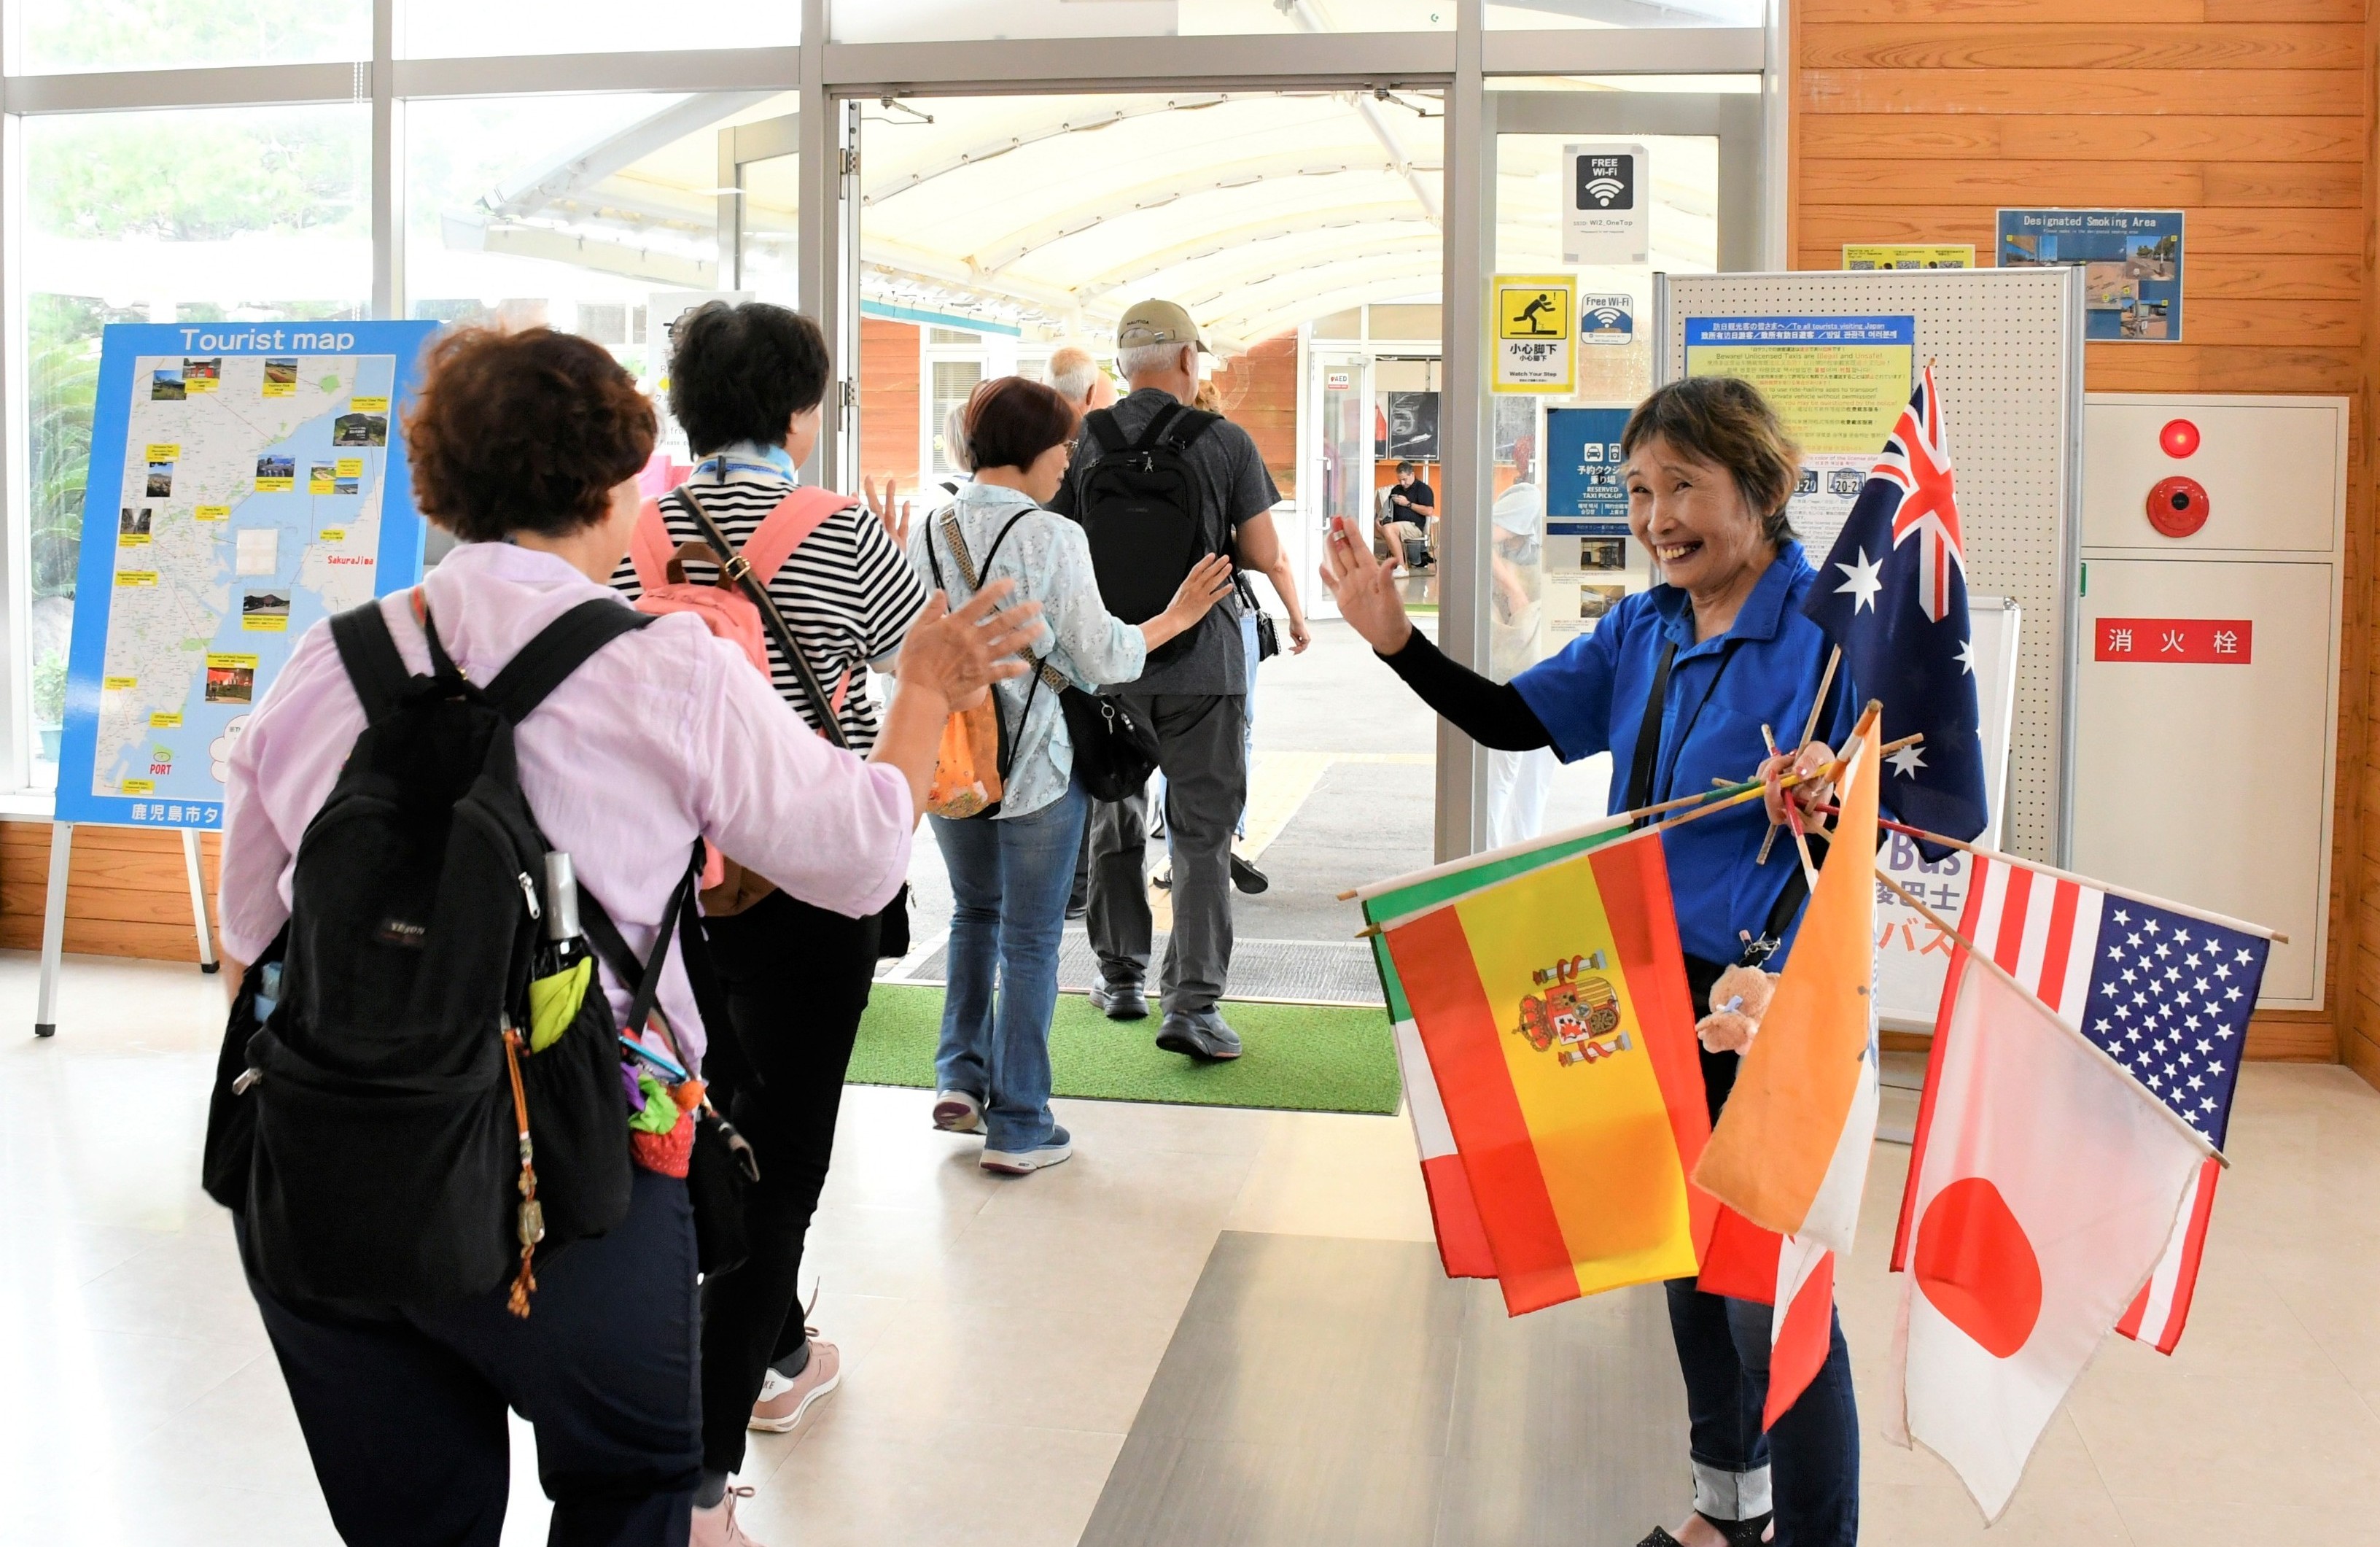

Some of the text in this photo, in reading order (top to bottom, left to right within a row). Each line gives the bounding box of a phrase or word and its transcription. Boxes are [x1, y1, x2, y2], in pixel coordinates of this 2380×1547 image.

[1591, 158, 1618, 167] FREE
[1592, 167, 1617, 177] Wi-Fi
[2023, 215, 2156, 228] Designated Smoking Area
[1586, 296, 1629, 306] Free Wi-Fi
[1864, 322, 1886, 330] Japan
[179, 328, 355, 352] Tourist map
[1509, 344, 1558, 354] 小心脚下
[1576, 465, 1619, 475] 予約タクシ
[1590, 475, 1616, 484] 乗り場
[1794, 479, 1816, 492] 0-20
[2108, 628, 2238, 654] 消火栓
[149, 764, 172, 775] PORT
[131, 803, 218, 823] 鹿児島市タ
[763, 1380, 775, 1389] KE
